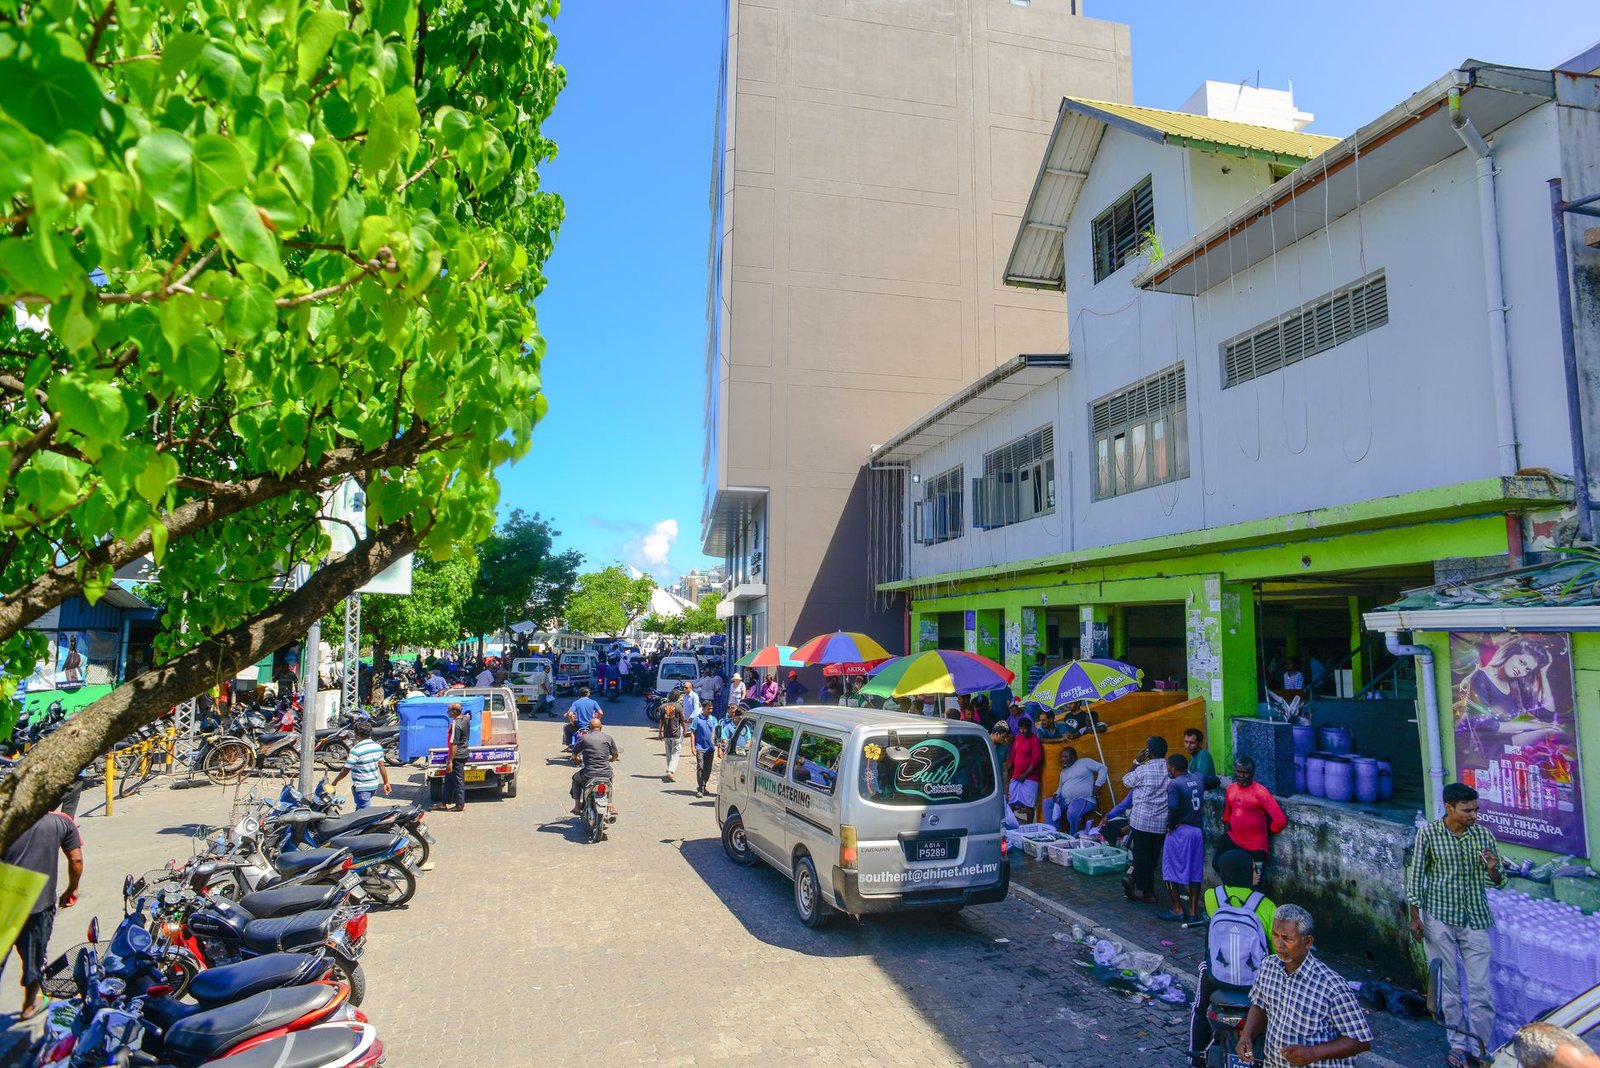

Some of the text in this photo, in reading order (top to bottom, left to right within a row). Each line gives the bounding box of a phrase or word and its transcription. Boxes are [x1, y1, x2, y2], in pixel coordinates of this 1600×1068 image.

[1061, 686, 1082, 699] FOSTER
[898, 747, 954, 783] South
[757, 775, 811, 808] SOUTH CATERING
[924, 783, 963, 794] Catering
[1487, 809, 1509, 817] Marketed
[1514, 814, 1541, 823] Distributed
[1476, 812, 1563, 836] SOSUN FIHAARA
[1498, 826, 1540, 839] 3320068
[919, 847, 946, 858] P5289
[858, 862, 998, 883] southent@dhinet.net.mv
